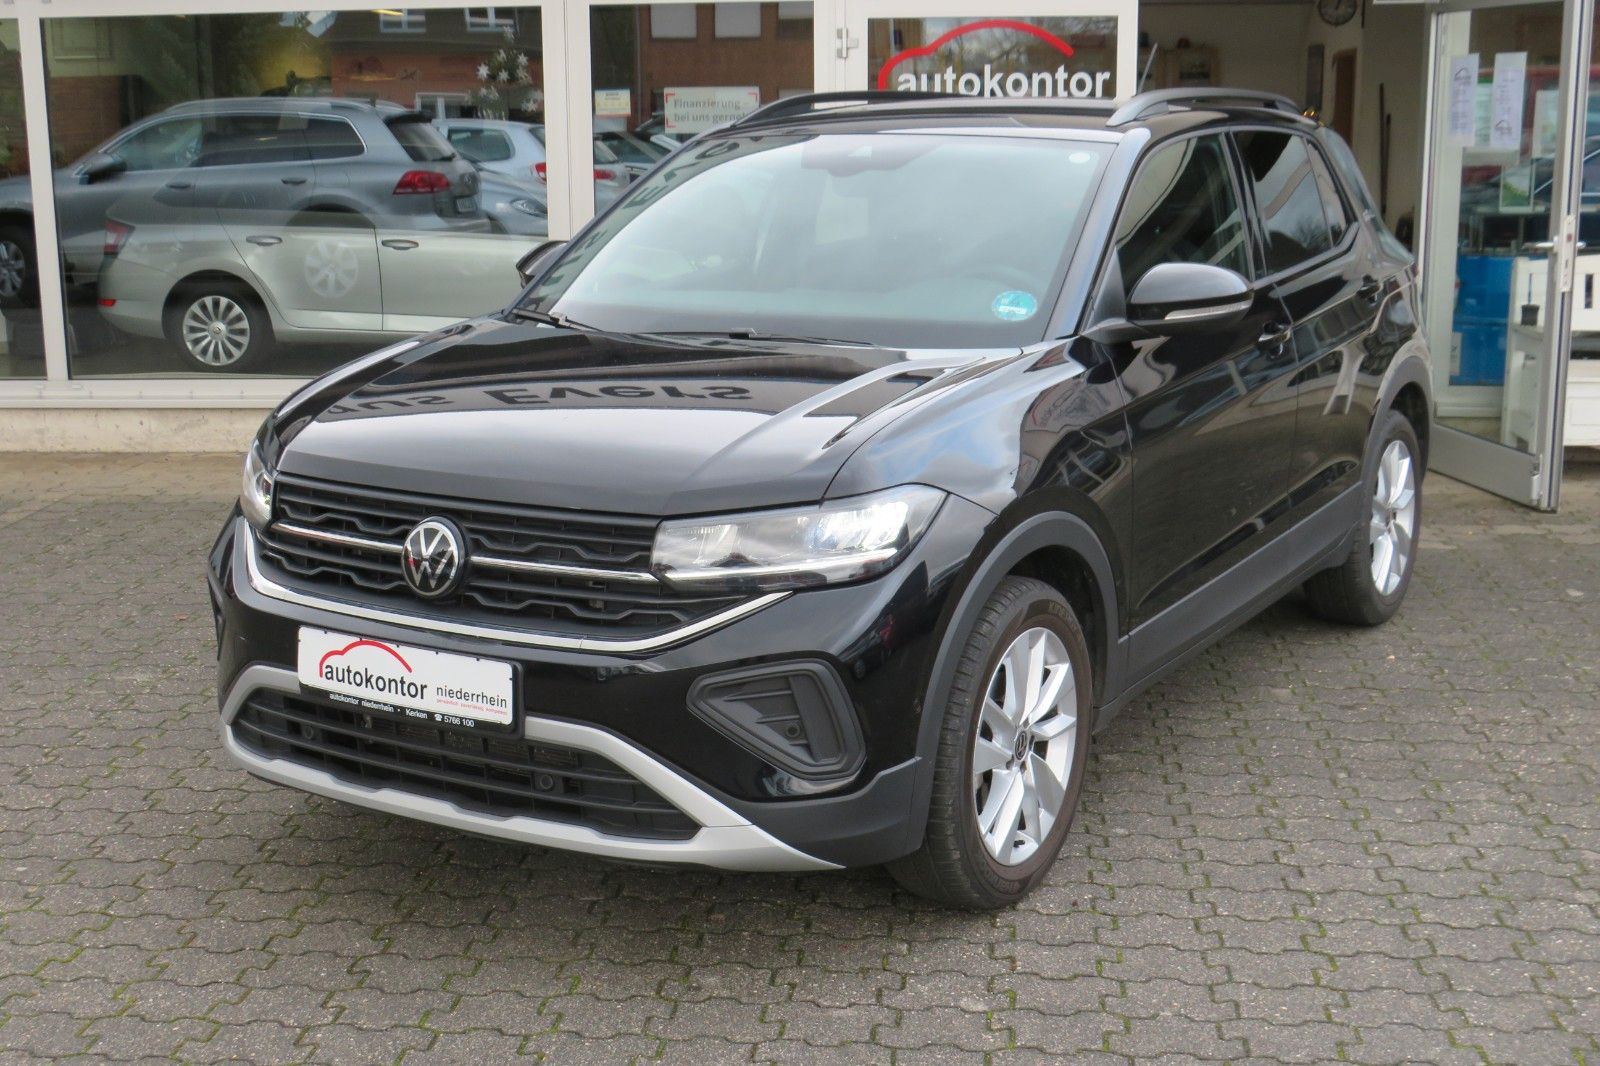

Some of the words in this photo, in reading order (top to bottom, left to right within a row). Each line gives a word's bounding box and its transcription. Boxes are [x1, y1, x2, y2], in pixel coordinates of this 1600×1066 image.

[897, 64, 1110, 98] autokontor
[674, 99, 740, 110] Finanzierung
[674, 112, 689, 121] bei
[324, 664, 428, 700] autokontor
[436, 685, 507, 709] niederrhein
[405, 708, 428, 720] Kerken
[462, 718, 475, 728] 100
